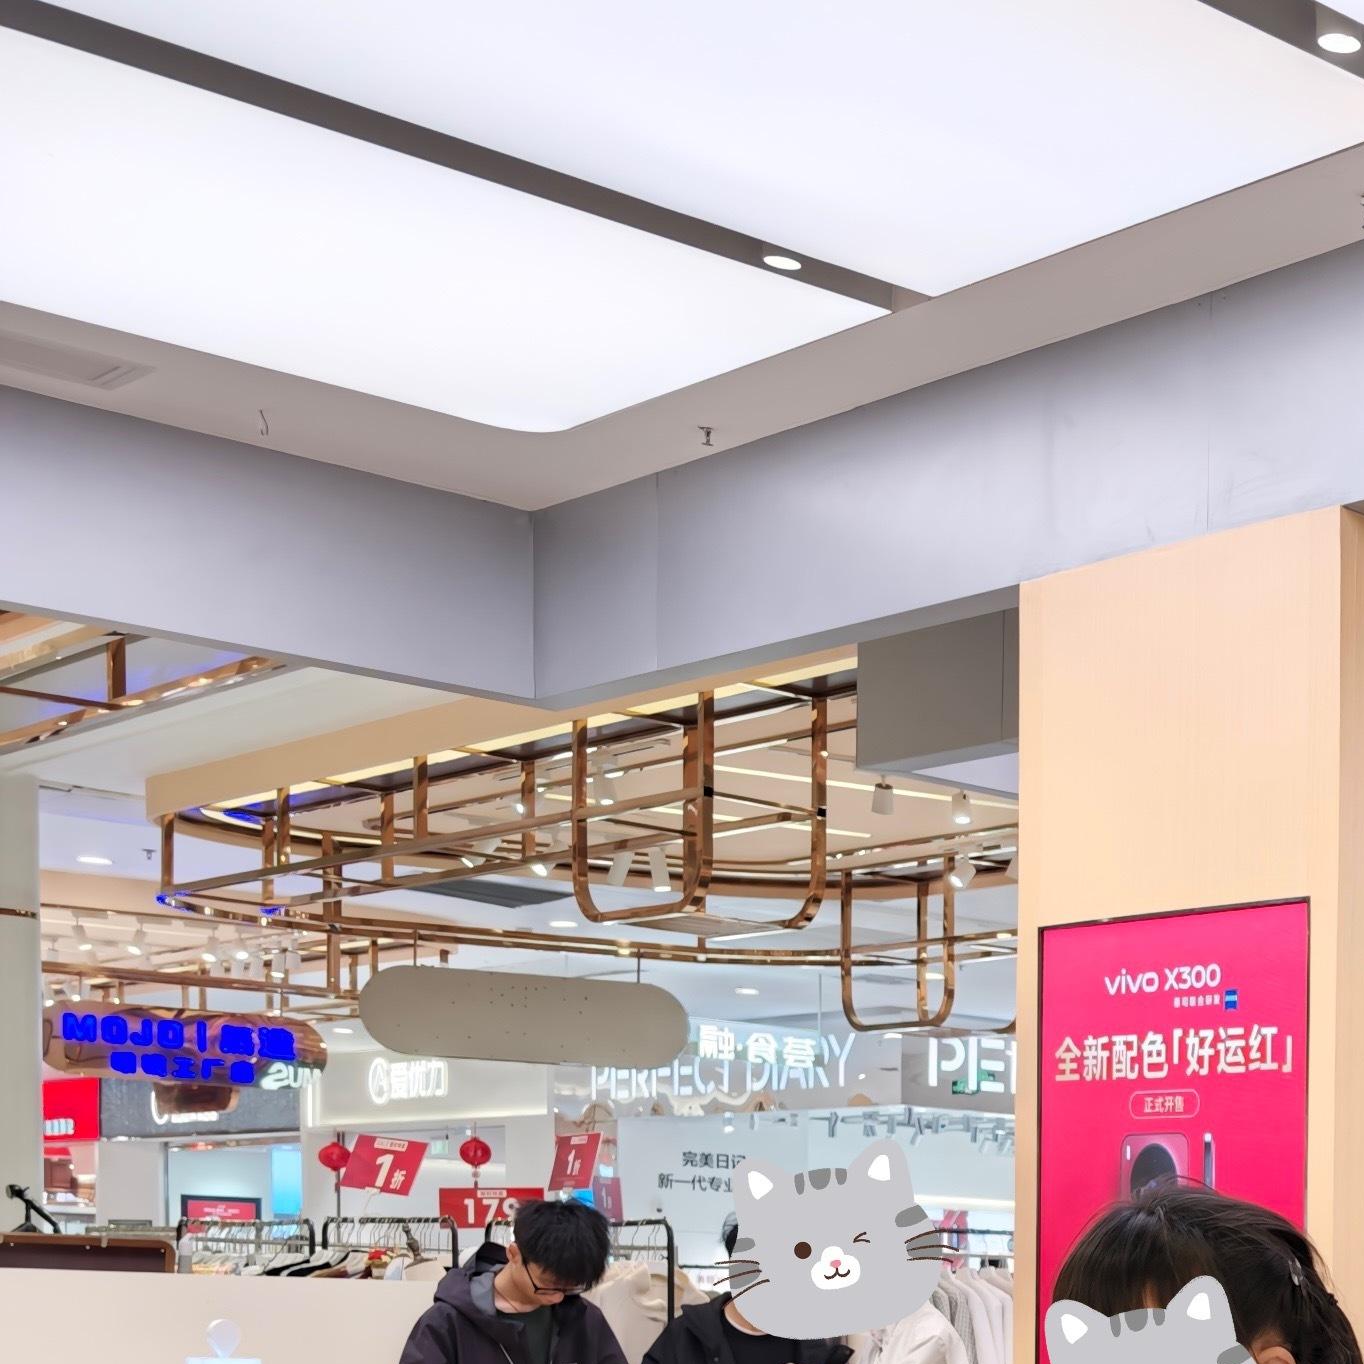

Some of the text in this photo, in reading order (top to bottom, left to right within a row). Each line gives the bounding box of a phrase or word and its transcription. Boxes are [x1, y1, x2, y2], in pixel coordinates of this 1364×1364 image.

[1105, 963, 1221, 995] vivo X300
[62, 1012, 184, 1050] MOJO
[1055, 1024, 1293, 1081] 全新配色「好运红」
[1143, 1095, 1184, 1113] 正式开售
